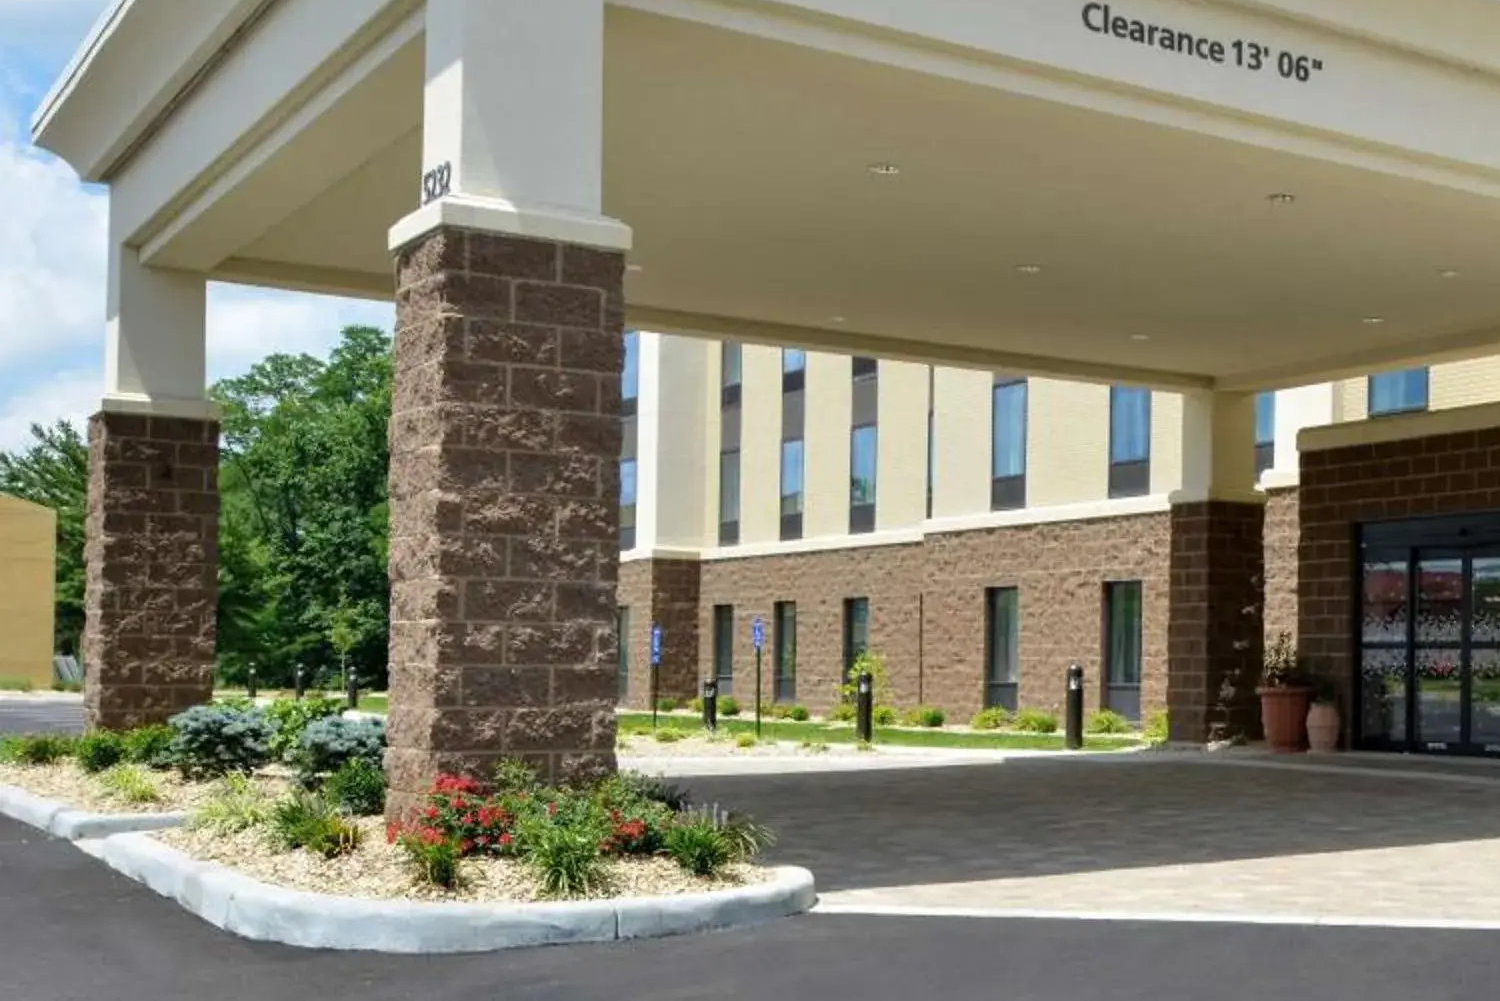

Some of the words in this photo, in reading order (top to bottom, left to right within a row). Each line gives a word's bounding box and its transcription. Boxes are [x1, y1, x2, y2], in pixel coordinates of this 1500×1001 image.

[1081, 1, 1226, 63] Clearance
[1231, 39, 1270, 71] 13'
[1277, 51, 1324, 82] 06"
